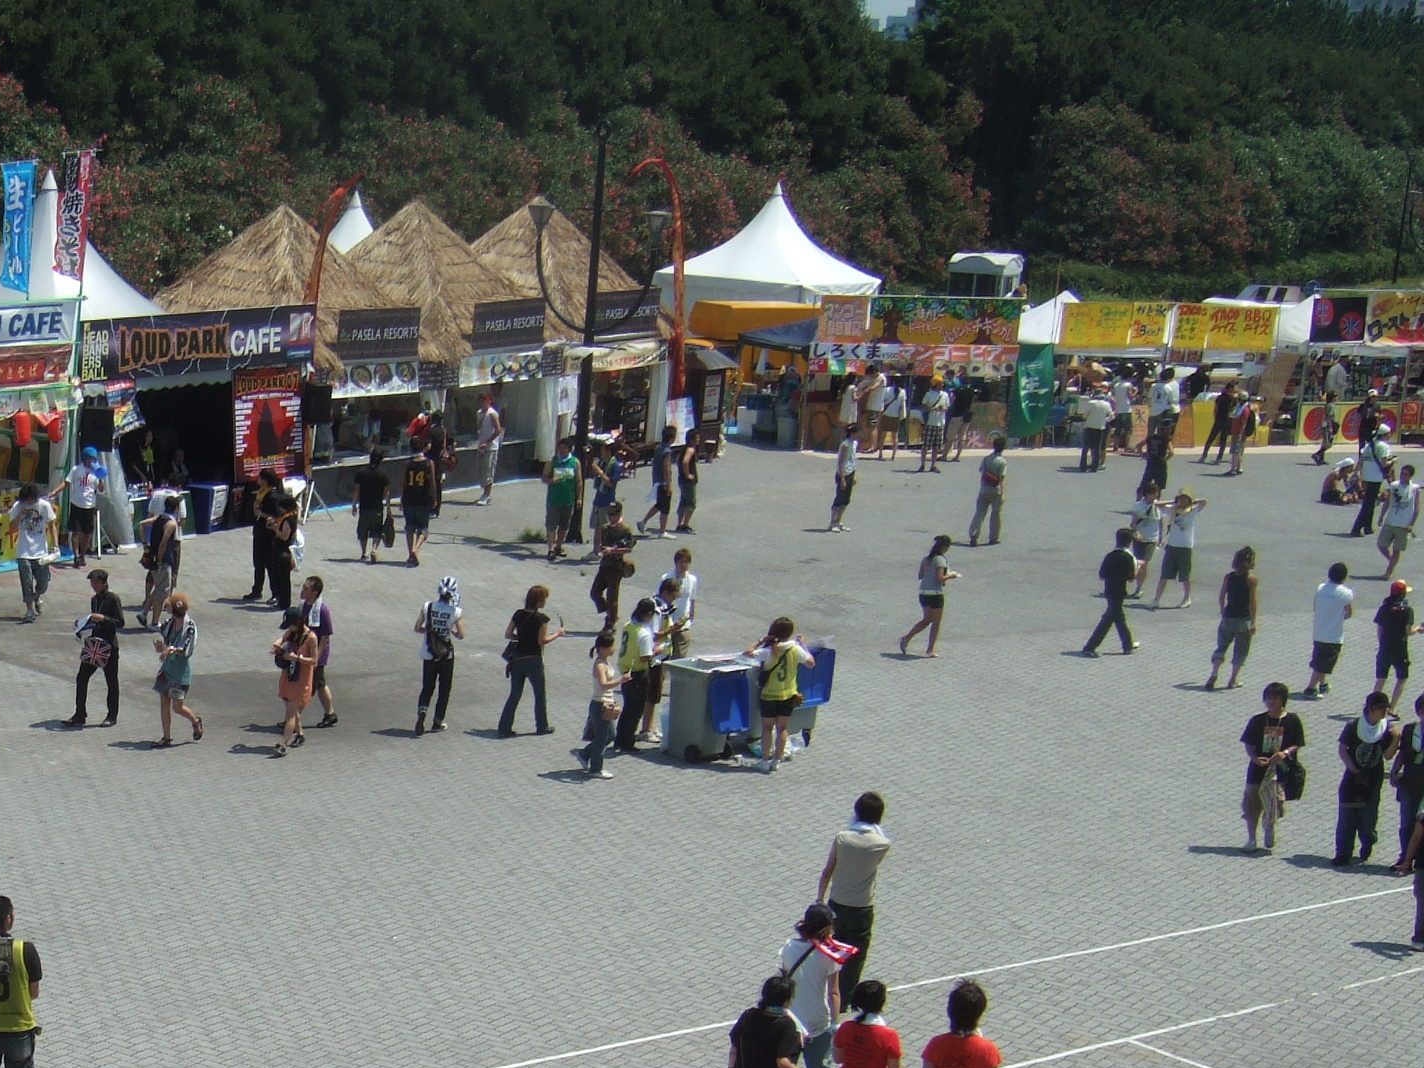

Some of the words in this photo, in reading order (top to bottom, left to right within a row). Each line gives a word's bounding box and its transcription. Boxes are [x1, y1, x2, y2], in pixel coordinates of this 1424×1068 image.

[7, 175, 27, 275] 生ビール
[8, 311, 64, 337] CAFE
[485, 320, 512, 332] PASELA
[512, 315, 545, 329] RESORTS
[84, 330, 109, 343] HEAD
[351, 328, 382, 341] PASELA
[383, 326, 418, 340] RESORTS
[84, 343, 109, 356] BANG
[119, 326, 172, 373] LOUD
[175, 324, 229, 360] PARK
[230, 327, 282, 357] CAFE
[813, 338, 880, 360] しろくま
[82, 356, 102, 369] ERS
[81, 367, 108, 381] BALL
[408, 470, 424, 487] 14
[777, 658, 789, 682] 3
